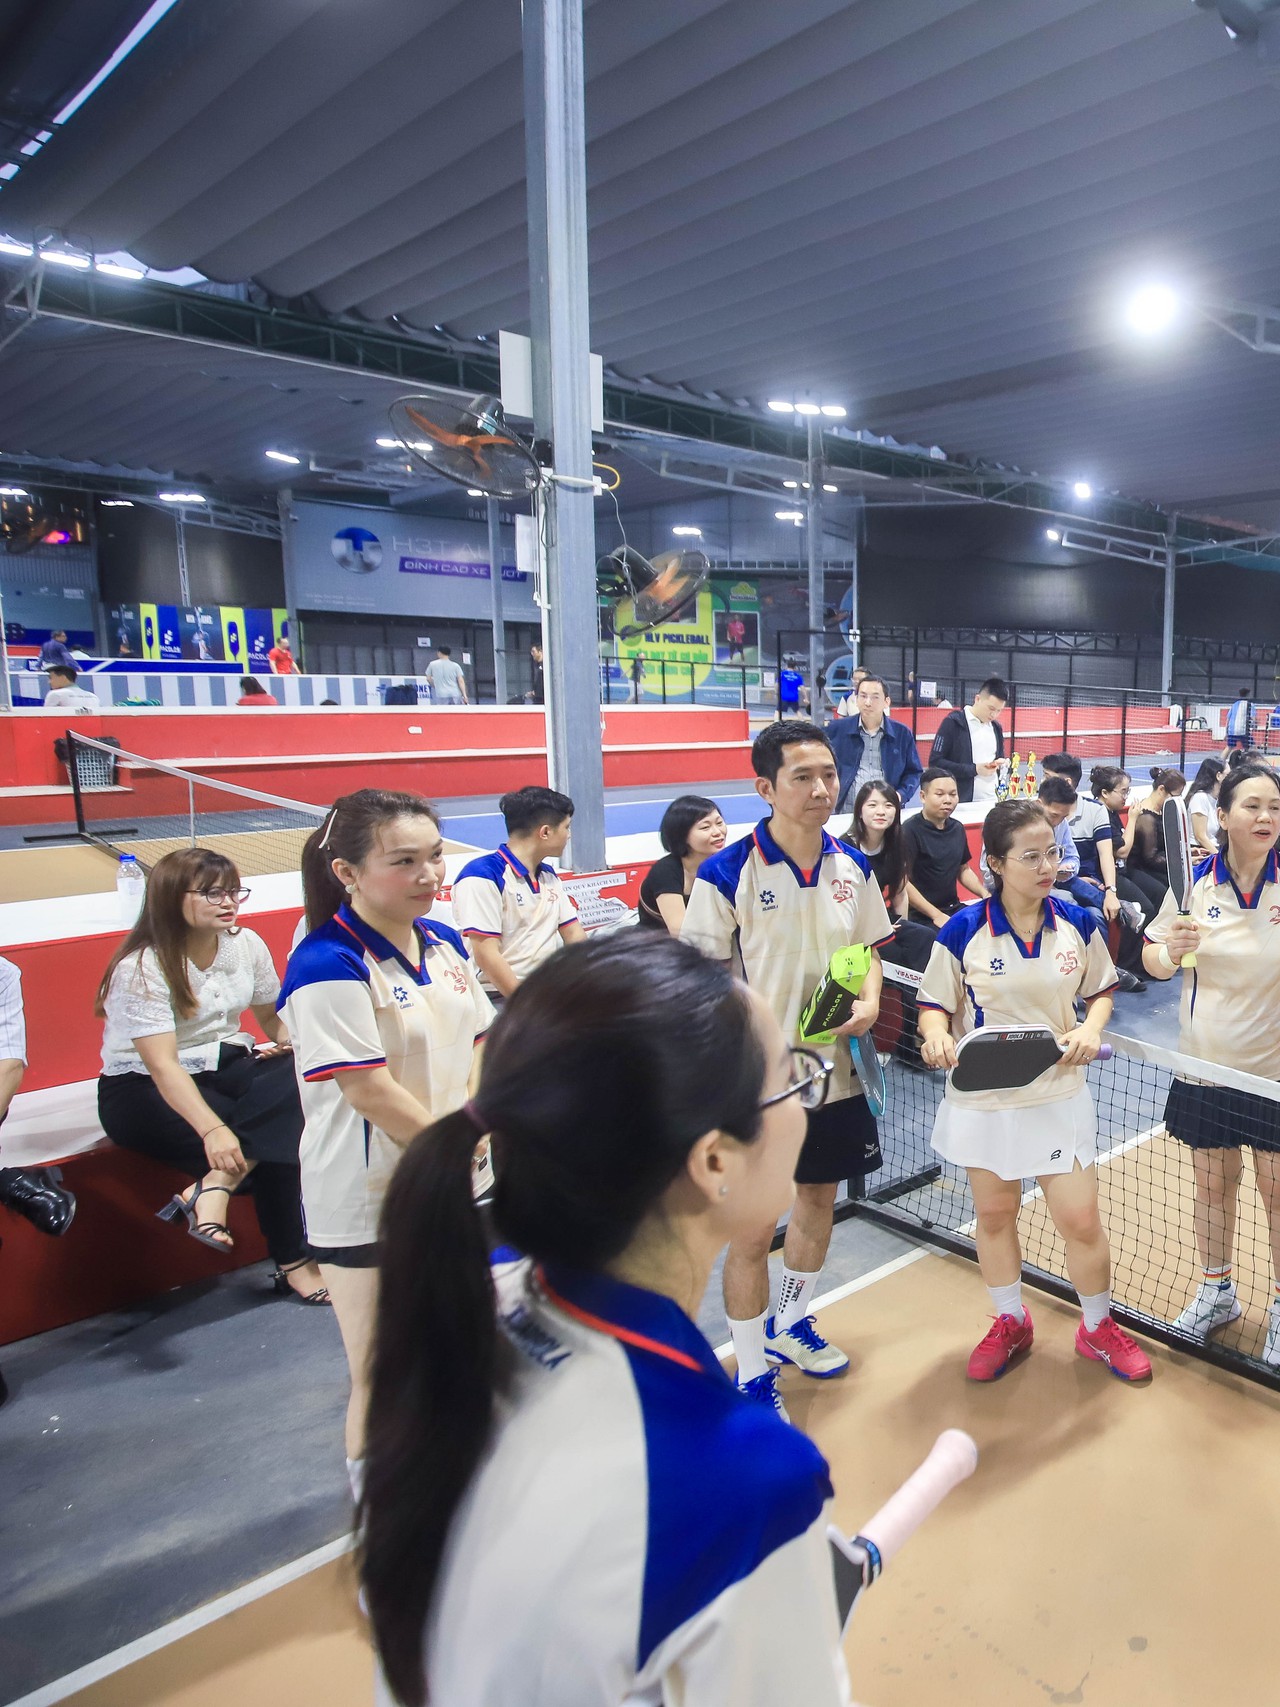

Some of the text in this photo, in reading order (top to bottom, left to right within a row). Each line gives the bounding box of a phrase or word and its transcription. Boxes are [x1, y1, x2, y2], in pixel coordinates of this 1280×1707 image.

[441, 562, 469, 576] CAO
[471, 566, 488, 577] XE
[663, 633, 710, 645] PICKLEBALL
[822, 994, 843, 1027] PACOLOS
